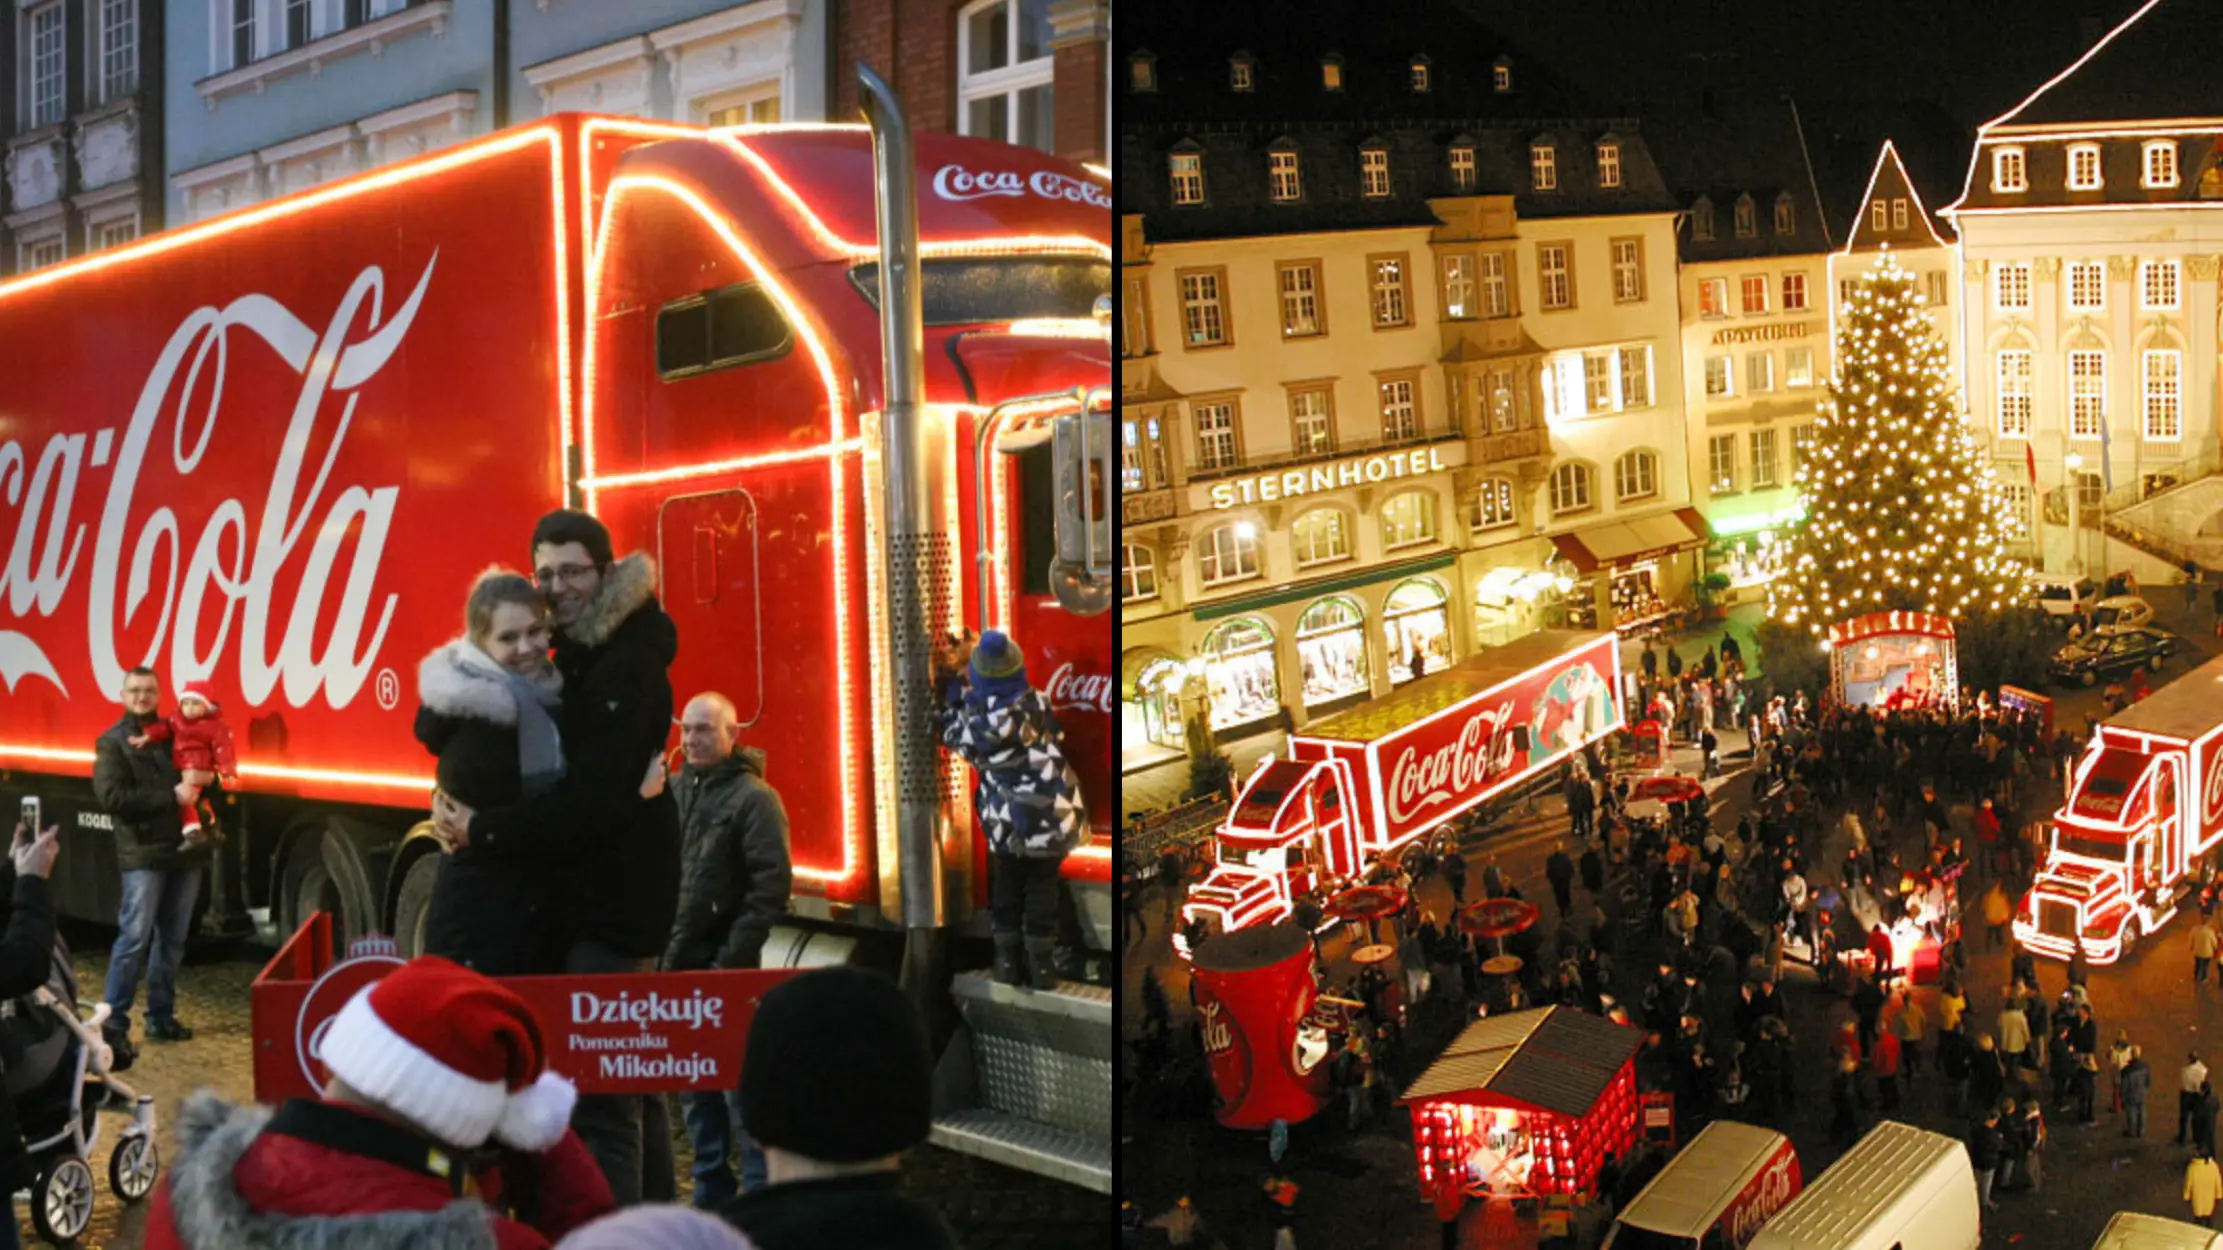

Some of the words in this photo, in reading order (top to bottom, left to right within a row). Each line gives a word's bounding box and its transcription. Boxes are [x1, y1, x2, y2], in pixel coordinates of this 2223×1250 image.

[933, 164, 1025, 200] Coca
[1211, 448, 1446, 509] STERNHOTEL
[570, 988, 723, 1030] Dziękuję
[568, 1033, 668, 1050] Pomocniku
[600, 1052, 718, 1083] Mikołaja
